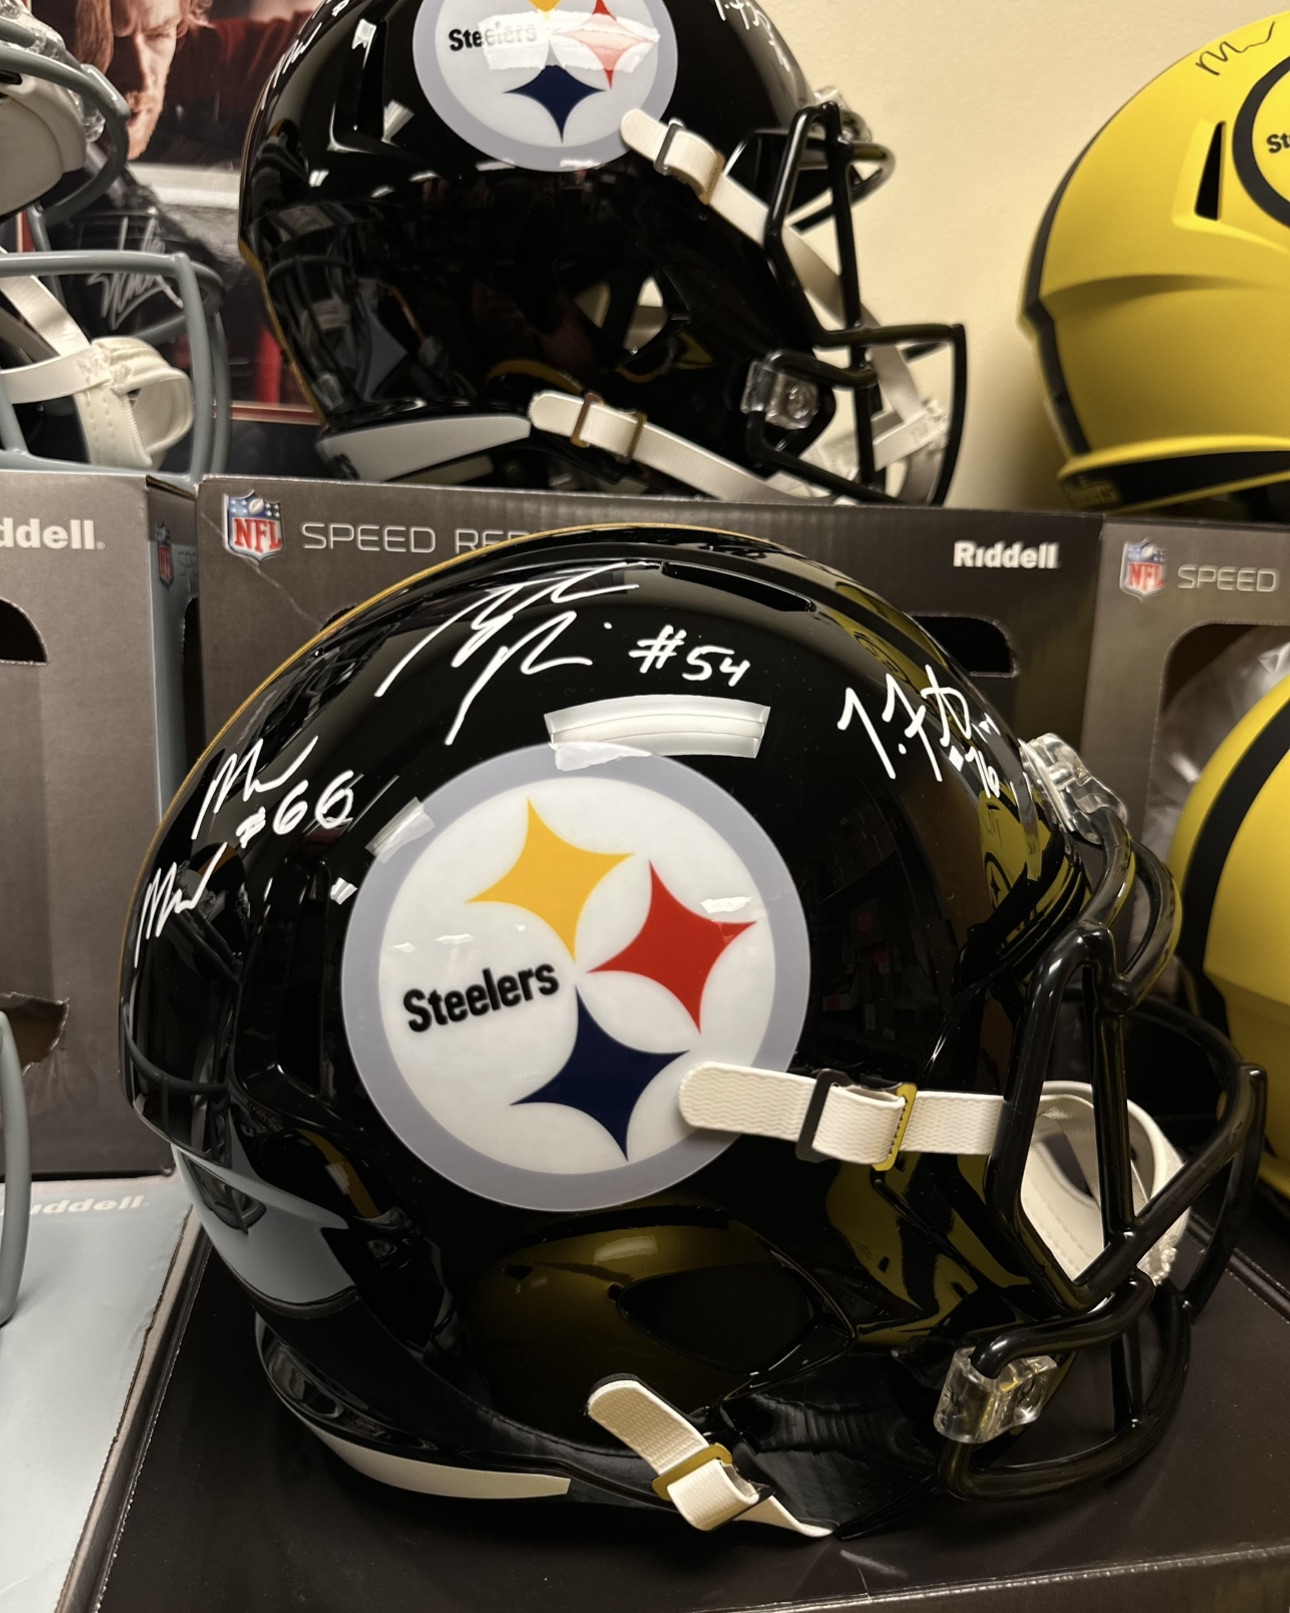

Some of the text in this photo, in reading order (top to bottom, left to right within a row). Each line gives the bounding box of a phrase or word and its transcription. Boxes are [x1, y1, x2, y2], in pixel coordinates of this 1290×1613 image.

[234, 518, 283, 553] NFL
[302, 521, 437, 554] SPEED
[953, 540, 1060, 569] Riddell
[1128, 562, 1165, 592] NFL
[1177, 563, 1280, 593] SPEED
[628, 624, 751, 687] #54
[235, 769, 355, 849] #66
[403, 963, 560, 1033] Steelers
